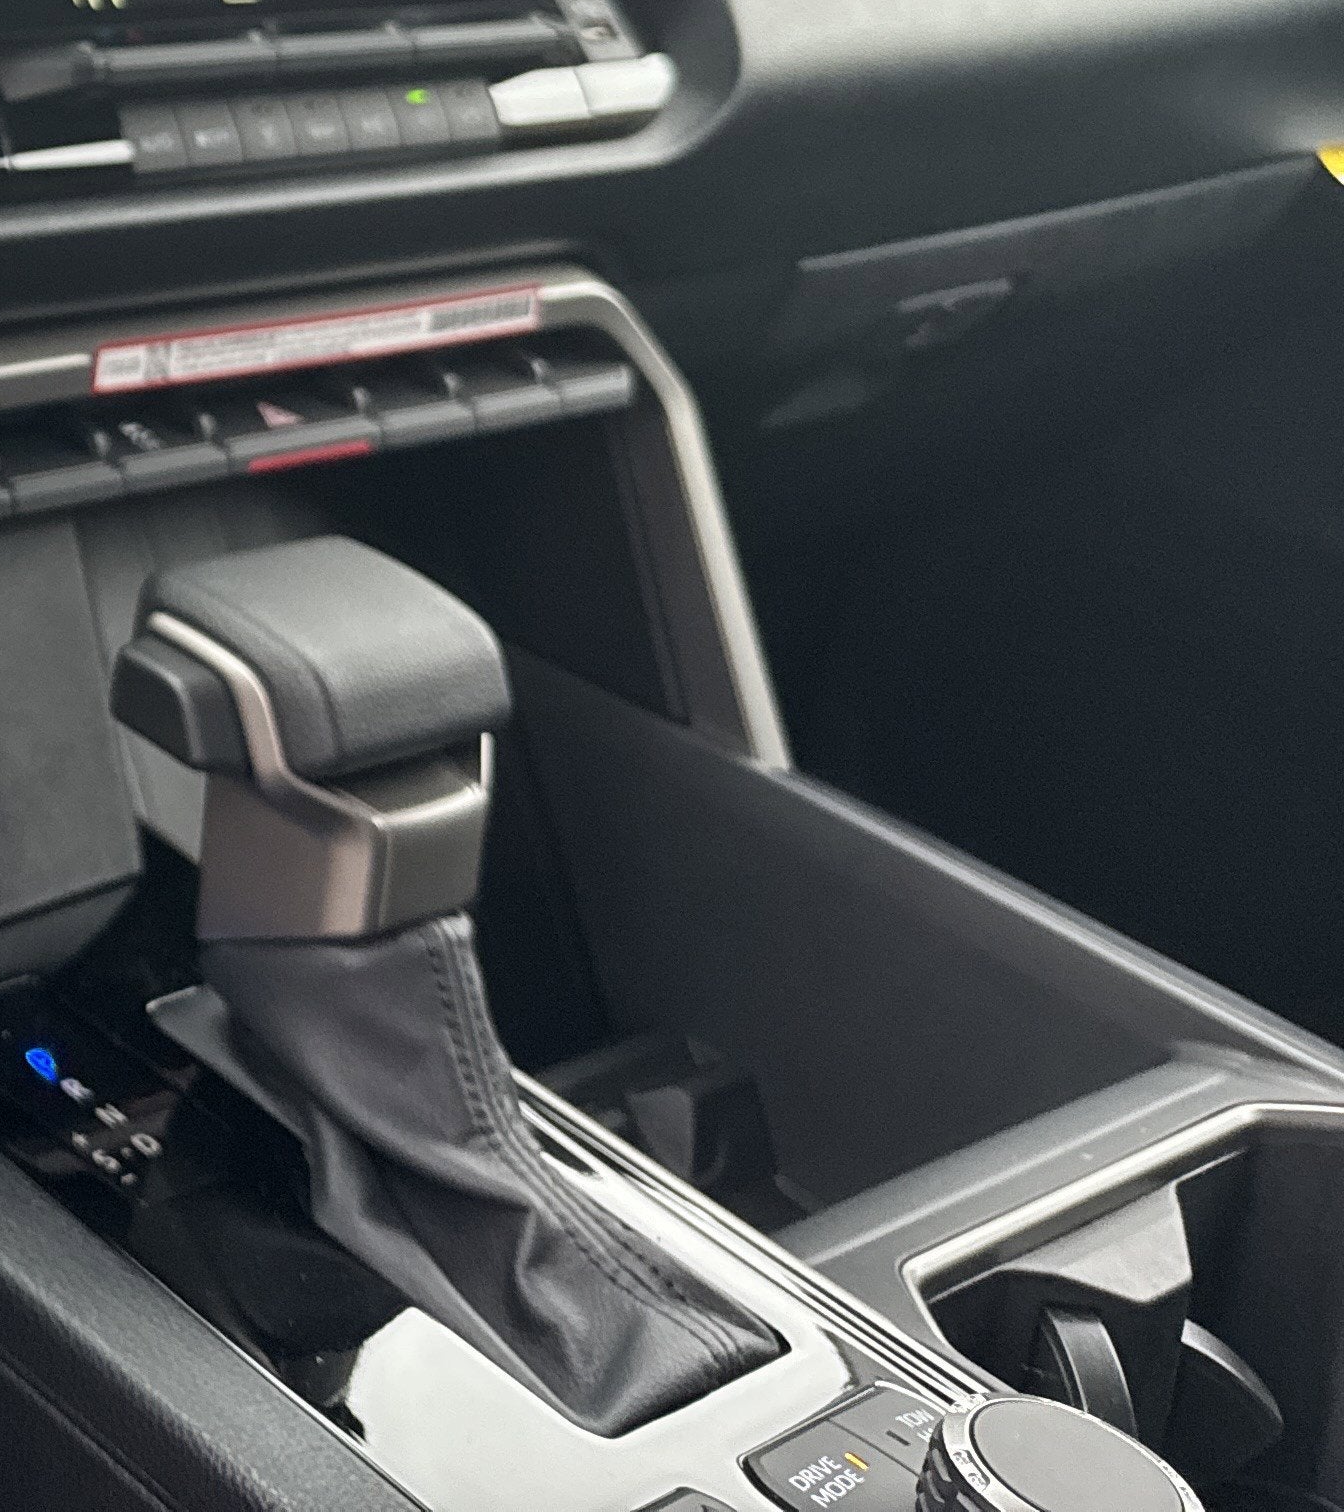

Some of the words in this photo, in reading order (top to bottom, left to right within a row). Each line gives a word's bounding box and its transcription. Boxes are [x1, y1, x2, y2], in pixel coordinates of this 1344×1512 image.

[895, 1408, 935, 1429] TOW
[788, 1454, 843, 1492] DRIVE
[810, 1467, 866, 1509] MODE
